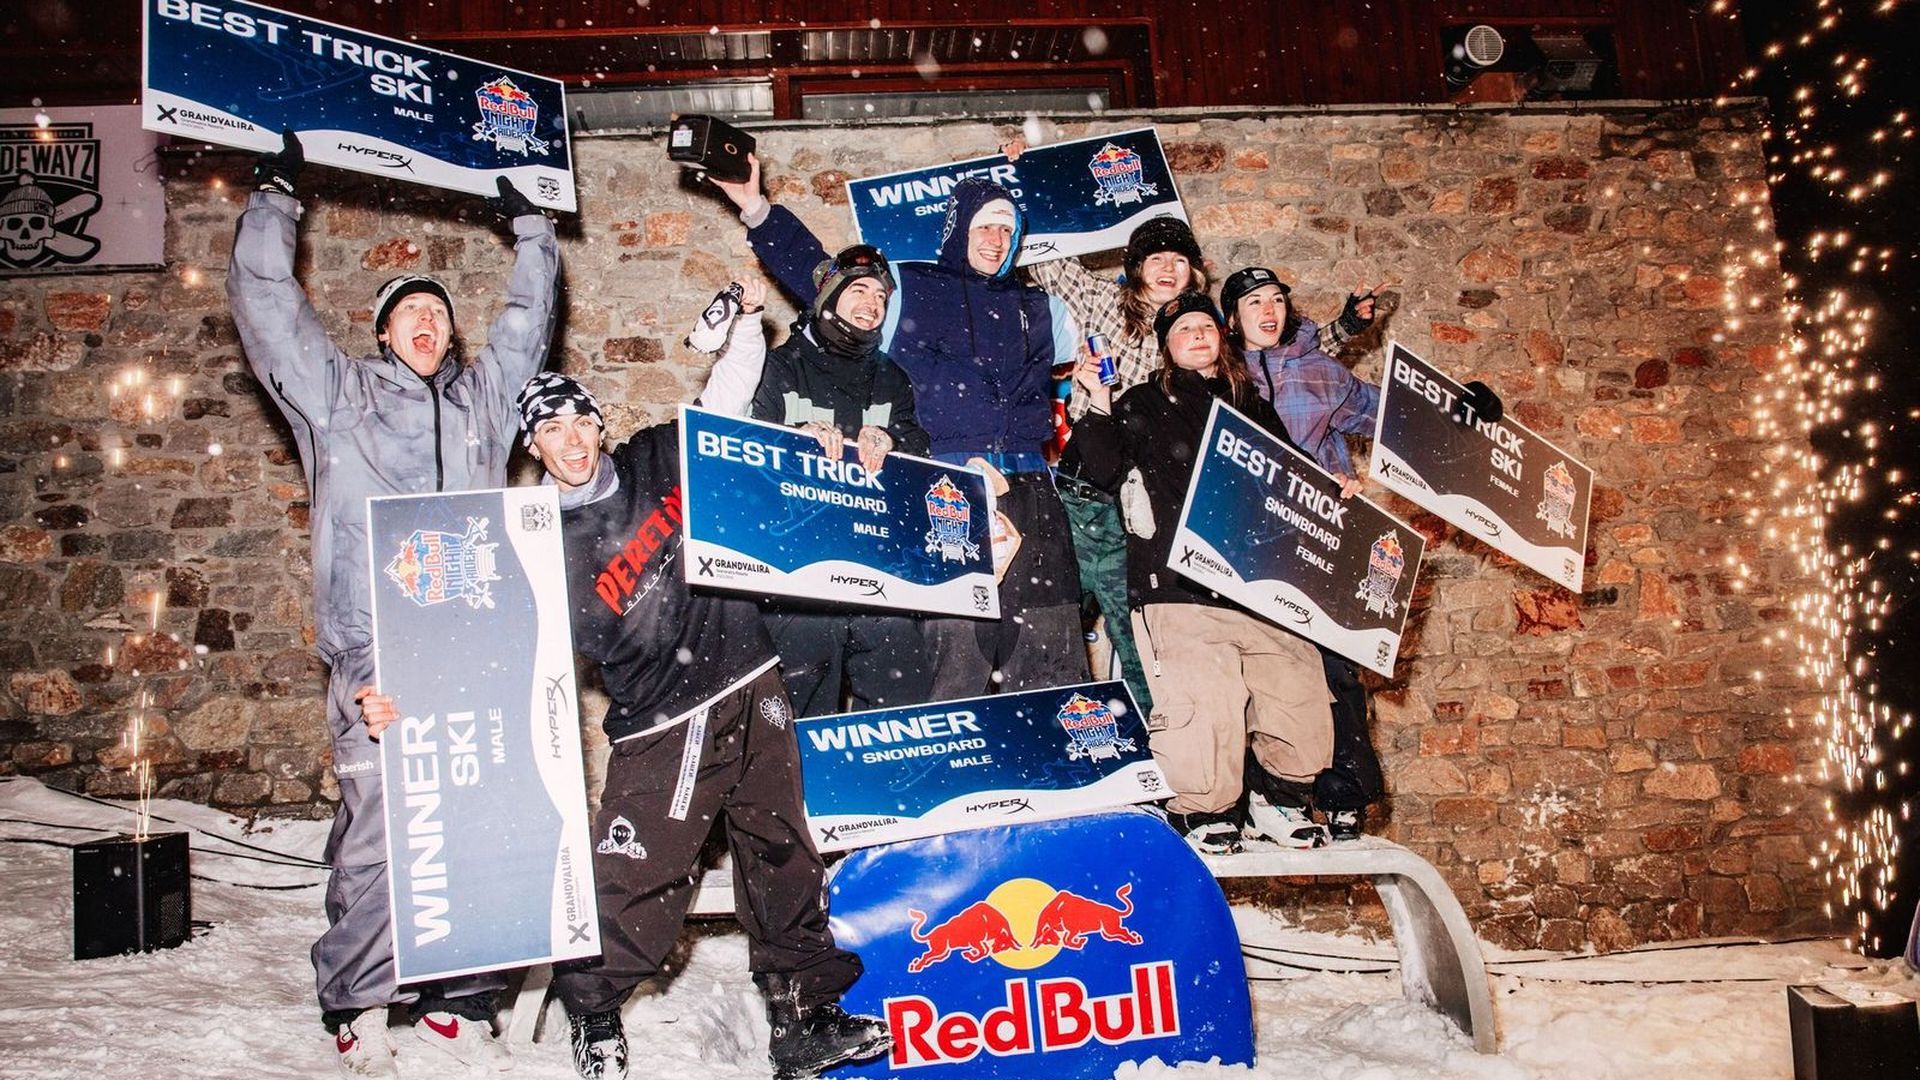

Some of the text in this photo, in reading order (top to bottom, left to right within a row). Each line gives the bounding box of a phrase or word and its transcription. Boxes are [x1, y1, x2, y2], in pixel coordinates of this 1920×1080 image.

[157, 0, 432, 82] BEST TRICK
[370, 73, 433, 105] SKI
[180, 109, 255, 132] GRANDVALIRA
[393, 106, 434, 123] MALE
[480, 97, 536, 119] Red Bull
[489, 111, 530, 132] NIGHT
[1394, 358, 1457, 413] BEST
[697, 430, 885, 491] BEST TRICK
[1490, 448, 1522, 481] SKI
[1216, 428, 1349, 530] BEST TRICK
[1490, 474, 1520, 498] FEMALE
[780, 481, 888, 514] SNOWBOARD
[929, 501, 968, 520] Red Bull
[853, 522, 890, 538] MALE
[1265, 496, 1341, 551] SNOWBOARD
[421, 533, 444, 601] Red Bull
[444, 543, 464, 594] NIGHT
[715, 558, 770, 574] GRANDVALIRA
[1194, 551, 1233, 578] GRANDVALIRA
[1296, 545, 1334, 575] FEMALE
[489, 707, 506, 763] MALE
[807, 710, 982, 752] WINNER
[1063, 713, 1114, 728] Red Bull
[447, 711, 480, 786] SKI
[862, 737, 986, 764] SNOWBOARD
[949, 754, 993, 769] MALE
[401, 713, 451, 947] WINNER
[838, 817, 898, 833] GRANDVALIRA
[561, 846, 577, 921] GRANDVALIRA
[885, 961, 1180, 1069] Red Bull
